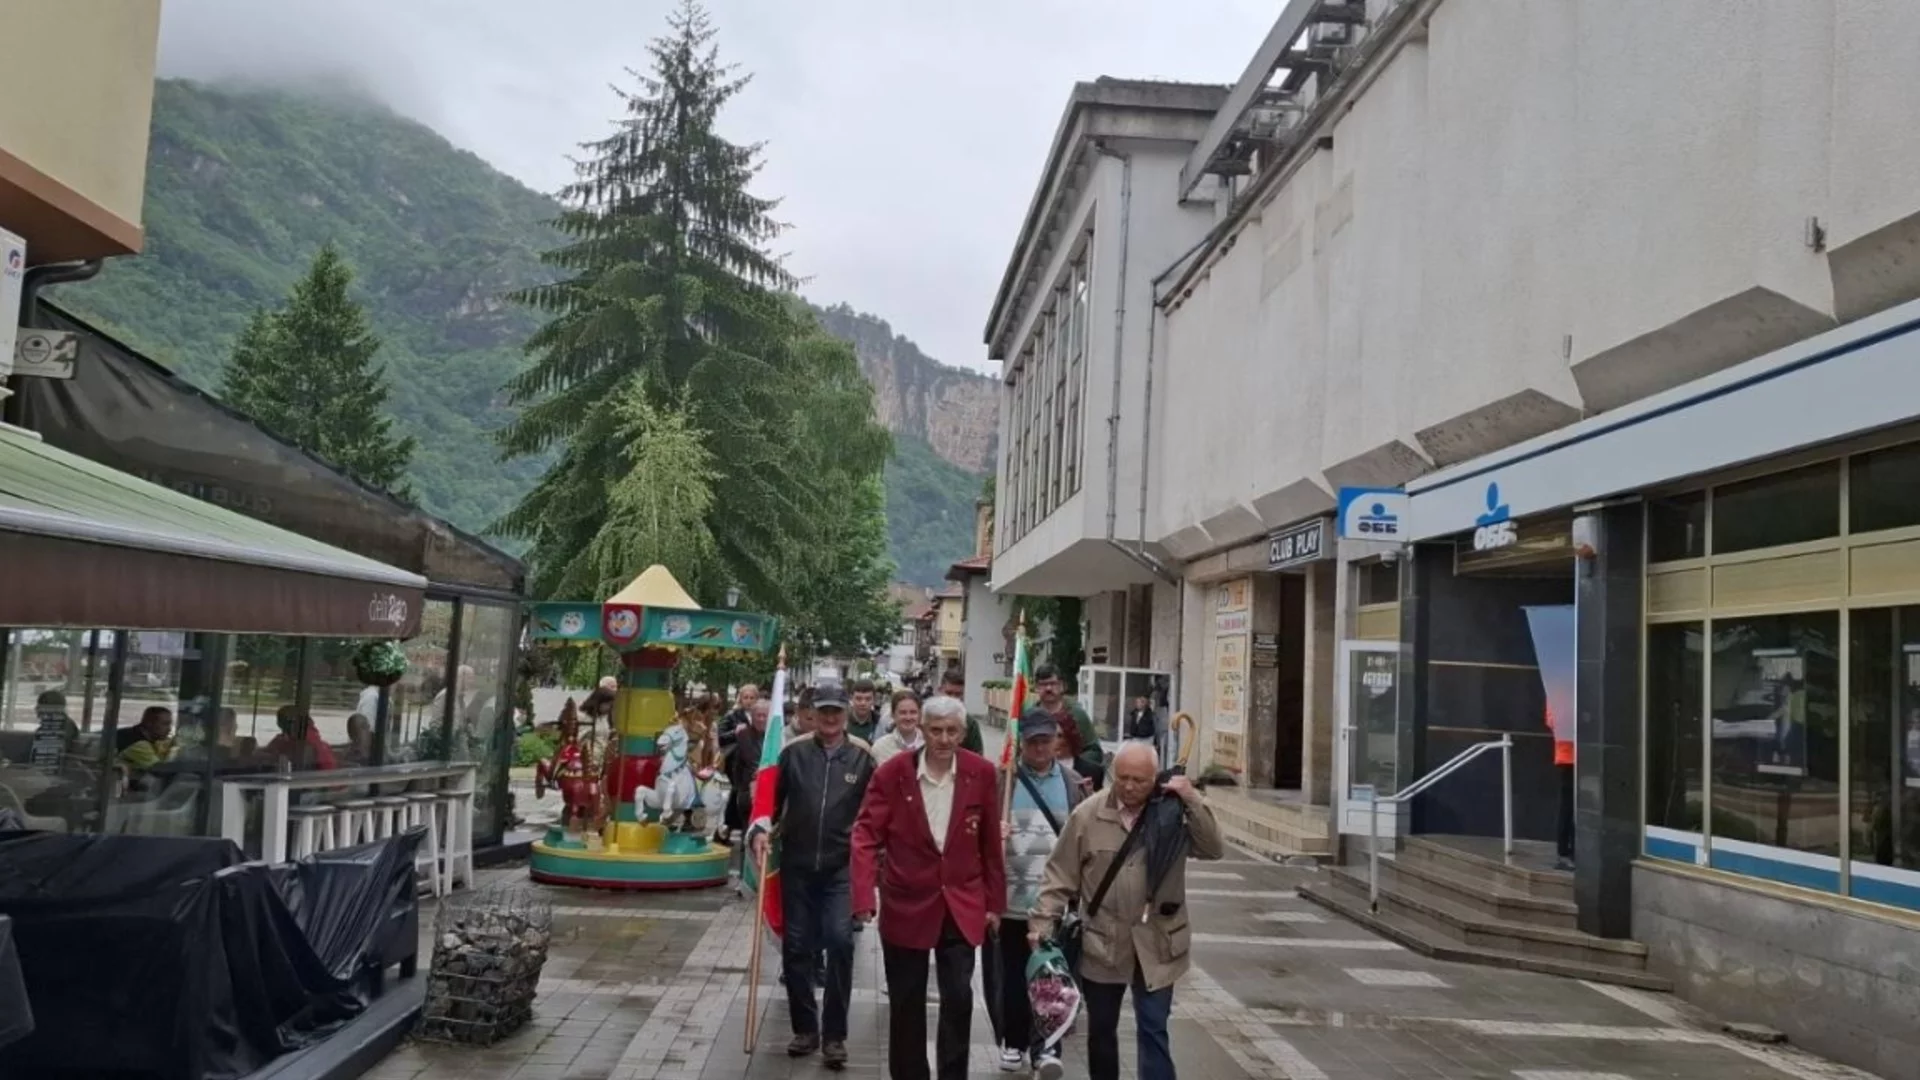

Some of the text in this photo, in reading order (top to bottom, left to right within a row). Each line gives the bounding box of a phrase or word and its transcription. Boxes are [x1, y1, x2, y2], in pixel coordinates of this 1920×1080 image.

[1358, 522, 1397, 533] ОББ
[1474, 521, 1516, 550] ОББ
[1271, 528, 1318, 562] CLUB PLAY
